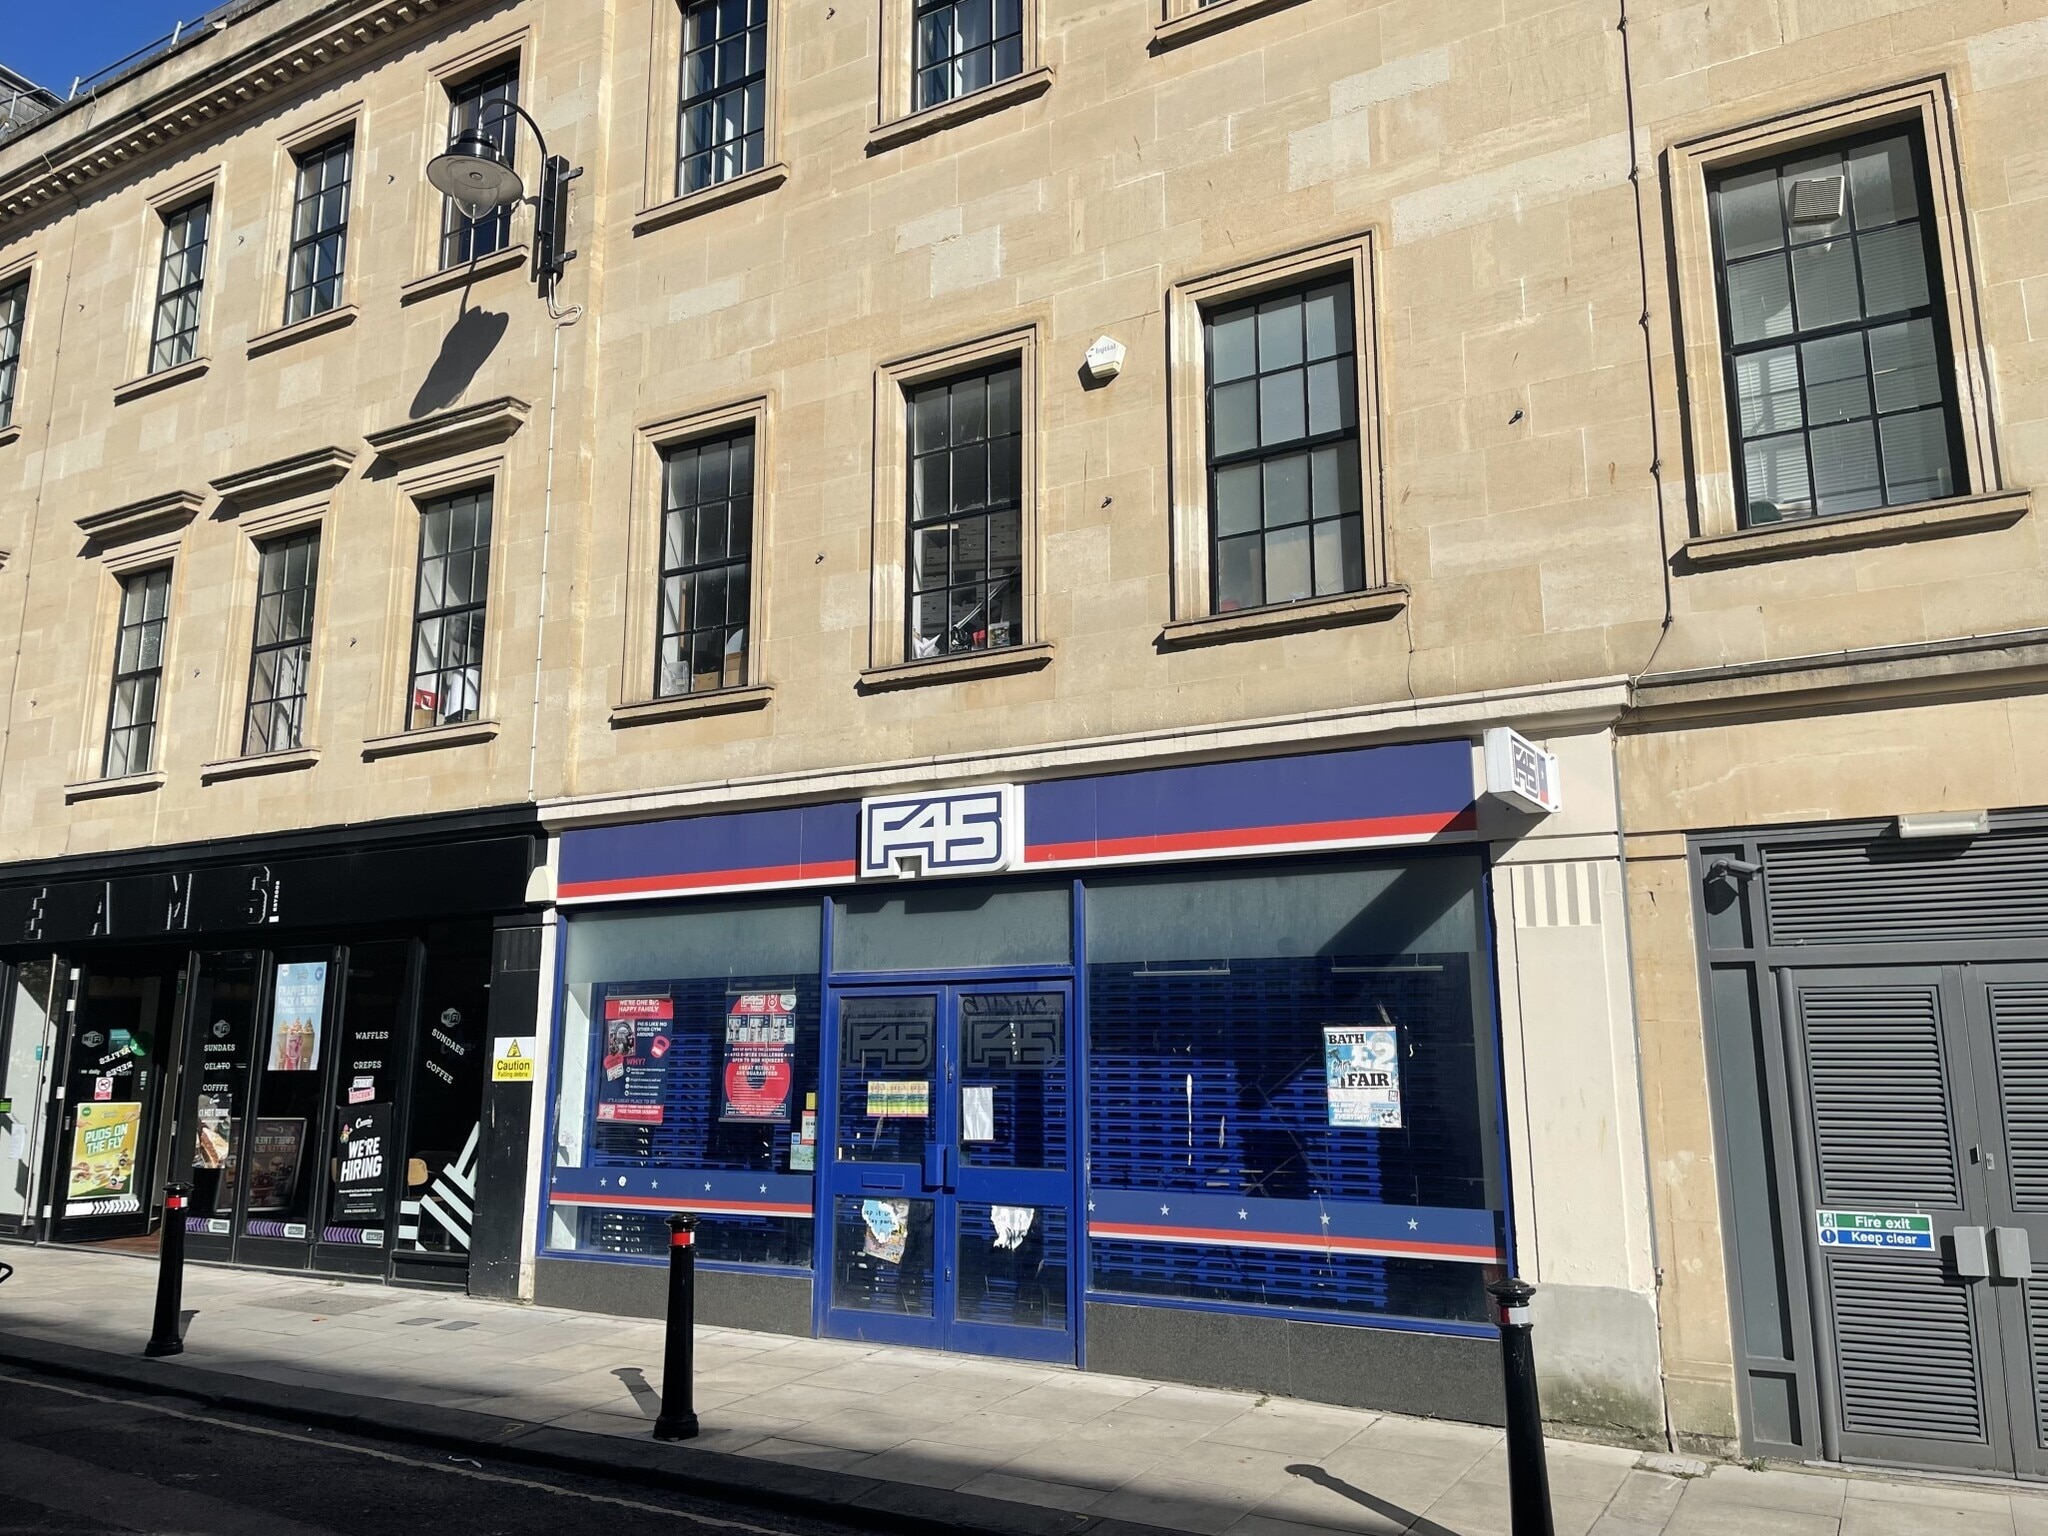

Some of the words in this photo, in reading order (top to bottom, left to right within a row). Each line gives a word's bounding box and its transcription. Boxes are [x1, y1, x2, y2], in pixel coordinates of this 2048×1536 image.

[1510, 735, 1539, 799] F45
[867, 791, 1003, 870] F45
[355, 1031, 389, 1040] WAFFLES
[431, 1028, 465, 1056] SUNDAES
[846, 1017, 932, 1069] F45
[966, 1014, 1060, 1069] F45
[1327, 1033, 1365, 1045] BATH
[204, 1044, 236, 1052] SUNDAES
[353, 1060, 382, 1070] CREPES
[426, 1060, 454, 1085] COFFEE
[496, 1060, 530, 1071] Caution
[1346, 1072, 1390, 1087] FAIR
[85, 1126, 111, 1143] PUDS
[114, 1122, 128, 1138] ON
[86, 1140, 104, 1155] THE
[107, 1136, 124, 1150] FLY
[349, 1137, 381, 1159] WE'RE
[340, 1156, 383, 1182] HIRING
[1854, 1215, 1882, 1228] Fire
[1885, 1217, 1911, 1229] exit
[1851, 1231, 1883, 1246] Keep
[1886, 1233, 1917, 1244] clear
